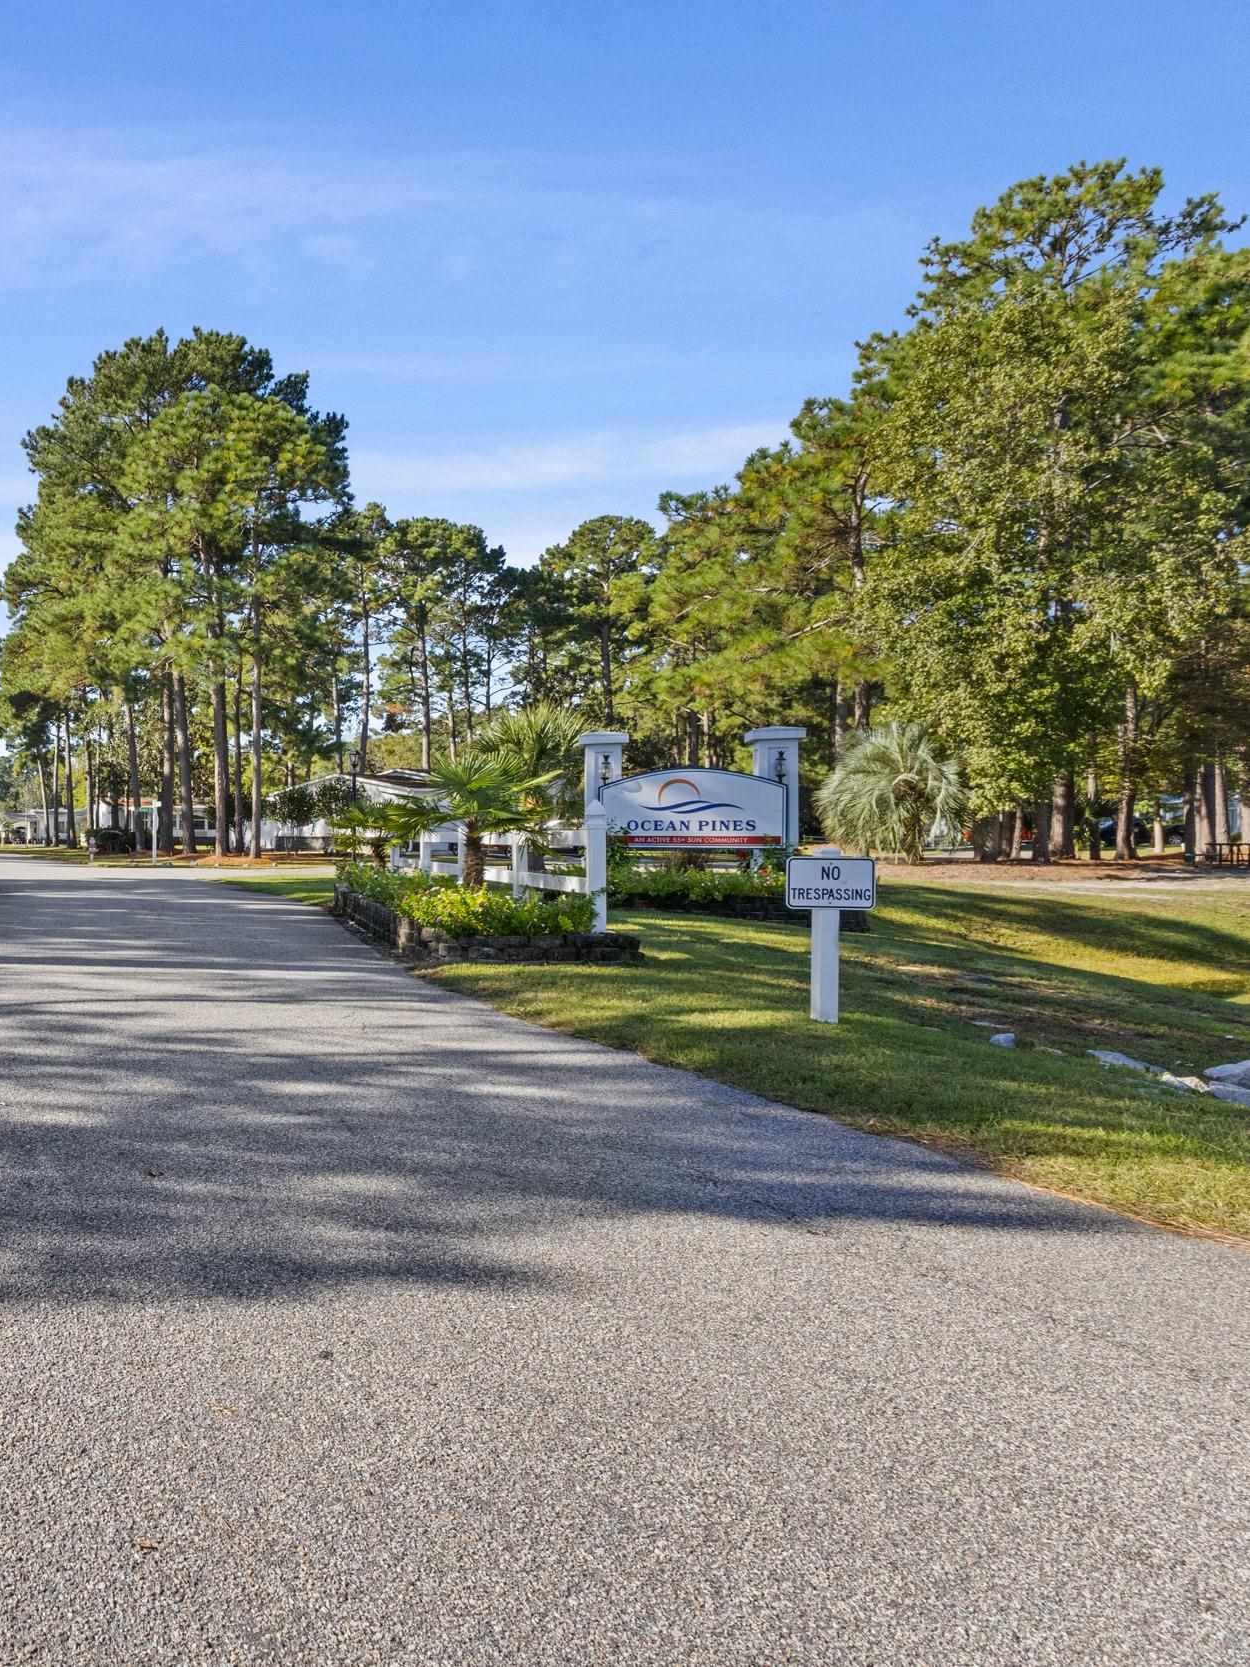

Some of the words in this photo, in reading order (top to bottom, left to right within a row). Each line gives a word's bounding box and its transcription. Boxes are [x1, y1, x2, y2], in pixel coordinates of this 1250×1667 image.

[627, 819, 690, 831] OCEAN
[698, 819, 757, 831] PINES
[821, 866, 841, 881] NO
[791, 888, 871, 901] TRESPASSING
